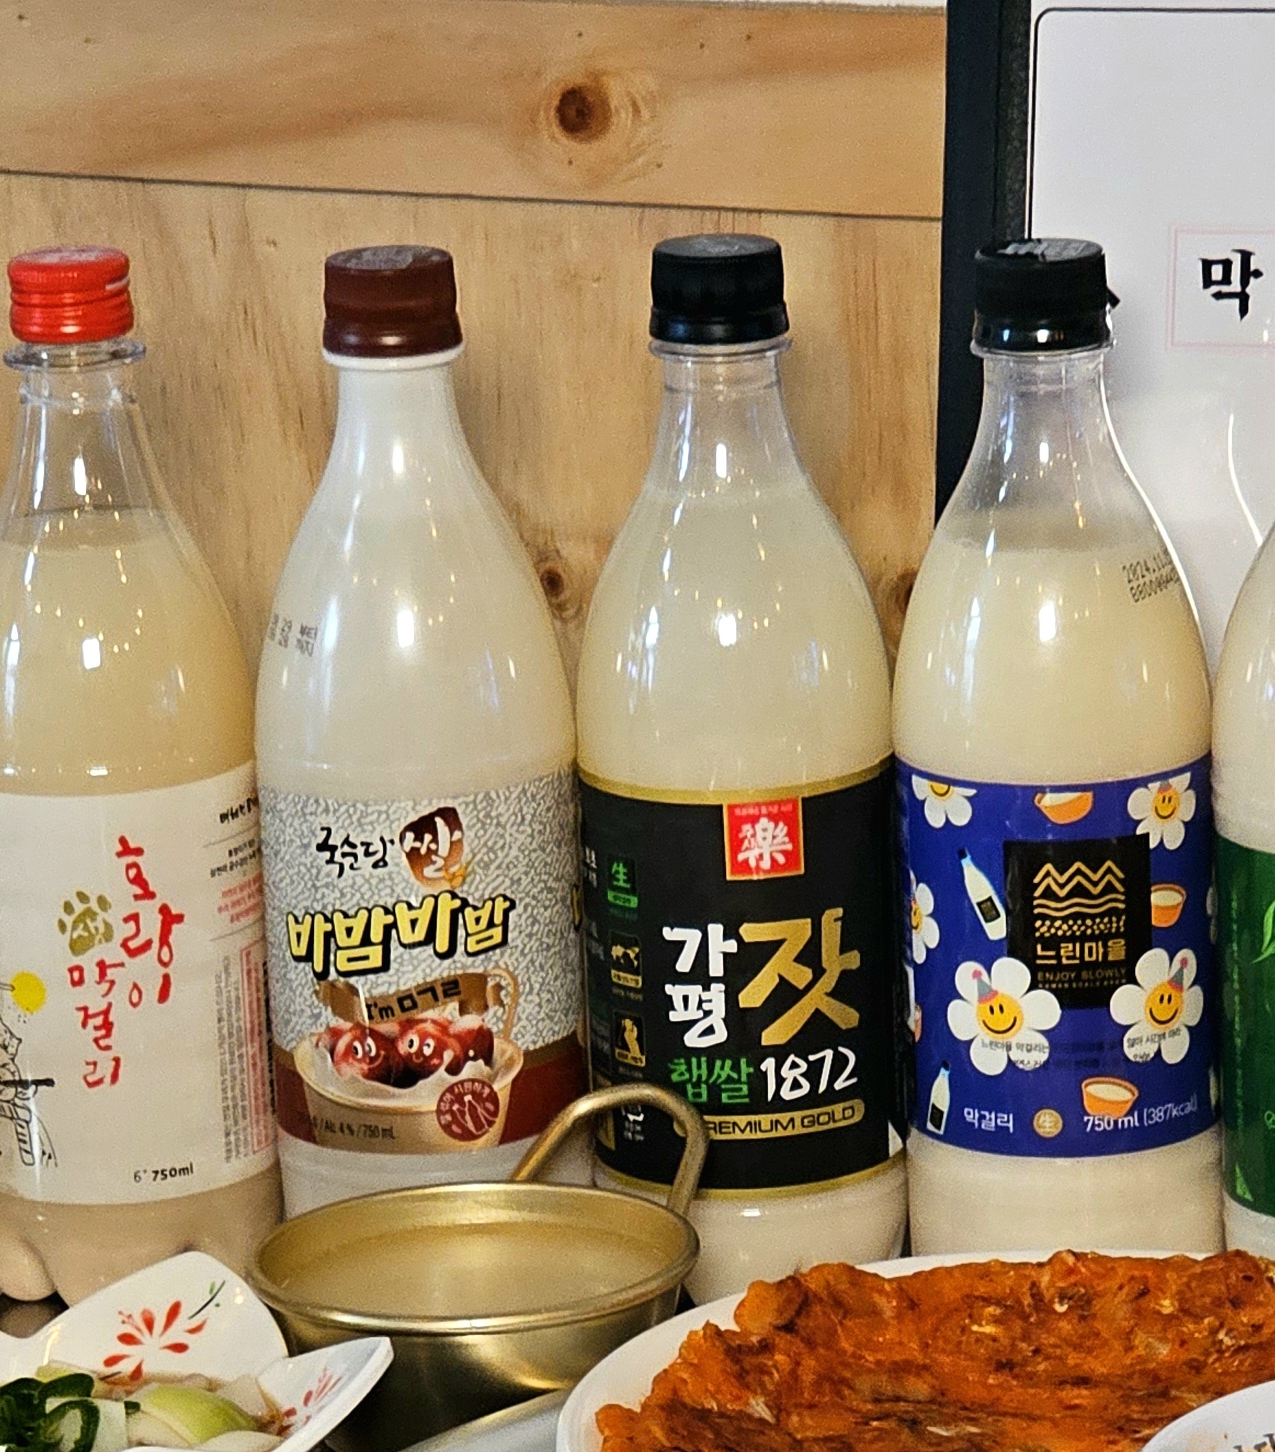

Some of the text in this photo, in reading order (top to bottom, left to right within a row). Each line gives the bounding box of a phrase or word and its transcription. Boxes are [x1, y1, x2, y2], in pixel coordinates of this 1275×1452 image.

[315, 826, 395, 879] 국순당
[115, 835, 185, 1009] 호랑이
[287, 890, 515, 980] 바밤바밤
[1035, 938, 1126, 965] 느린마을
[663, 906, 861, 1049] 가평 잣
[1036, 970, 1077, 981] ENJOY
[67, 958, 126, 1089] 막걸리
[668, 1046, 859, 1104] 햅쌀 1872
[708, 1104, 856, 1135] REMIUM GOLD
[963, 1107, 1014, 1133] 막걸리
[1083, 1115, 1115, 1133] 750
[1117, 1114, 1139, 1130] ml
[151, 1161, 194, 1182] 750ml
